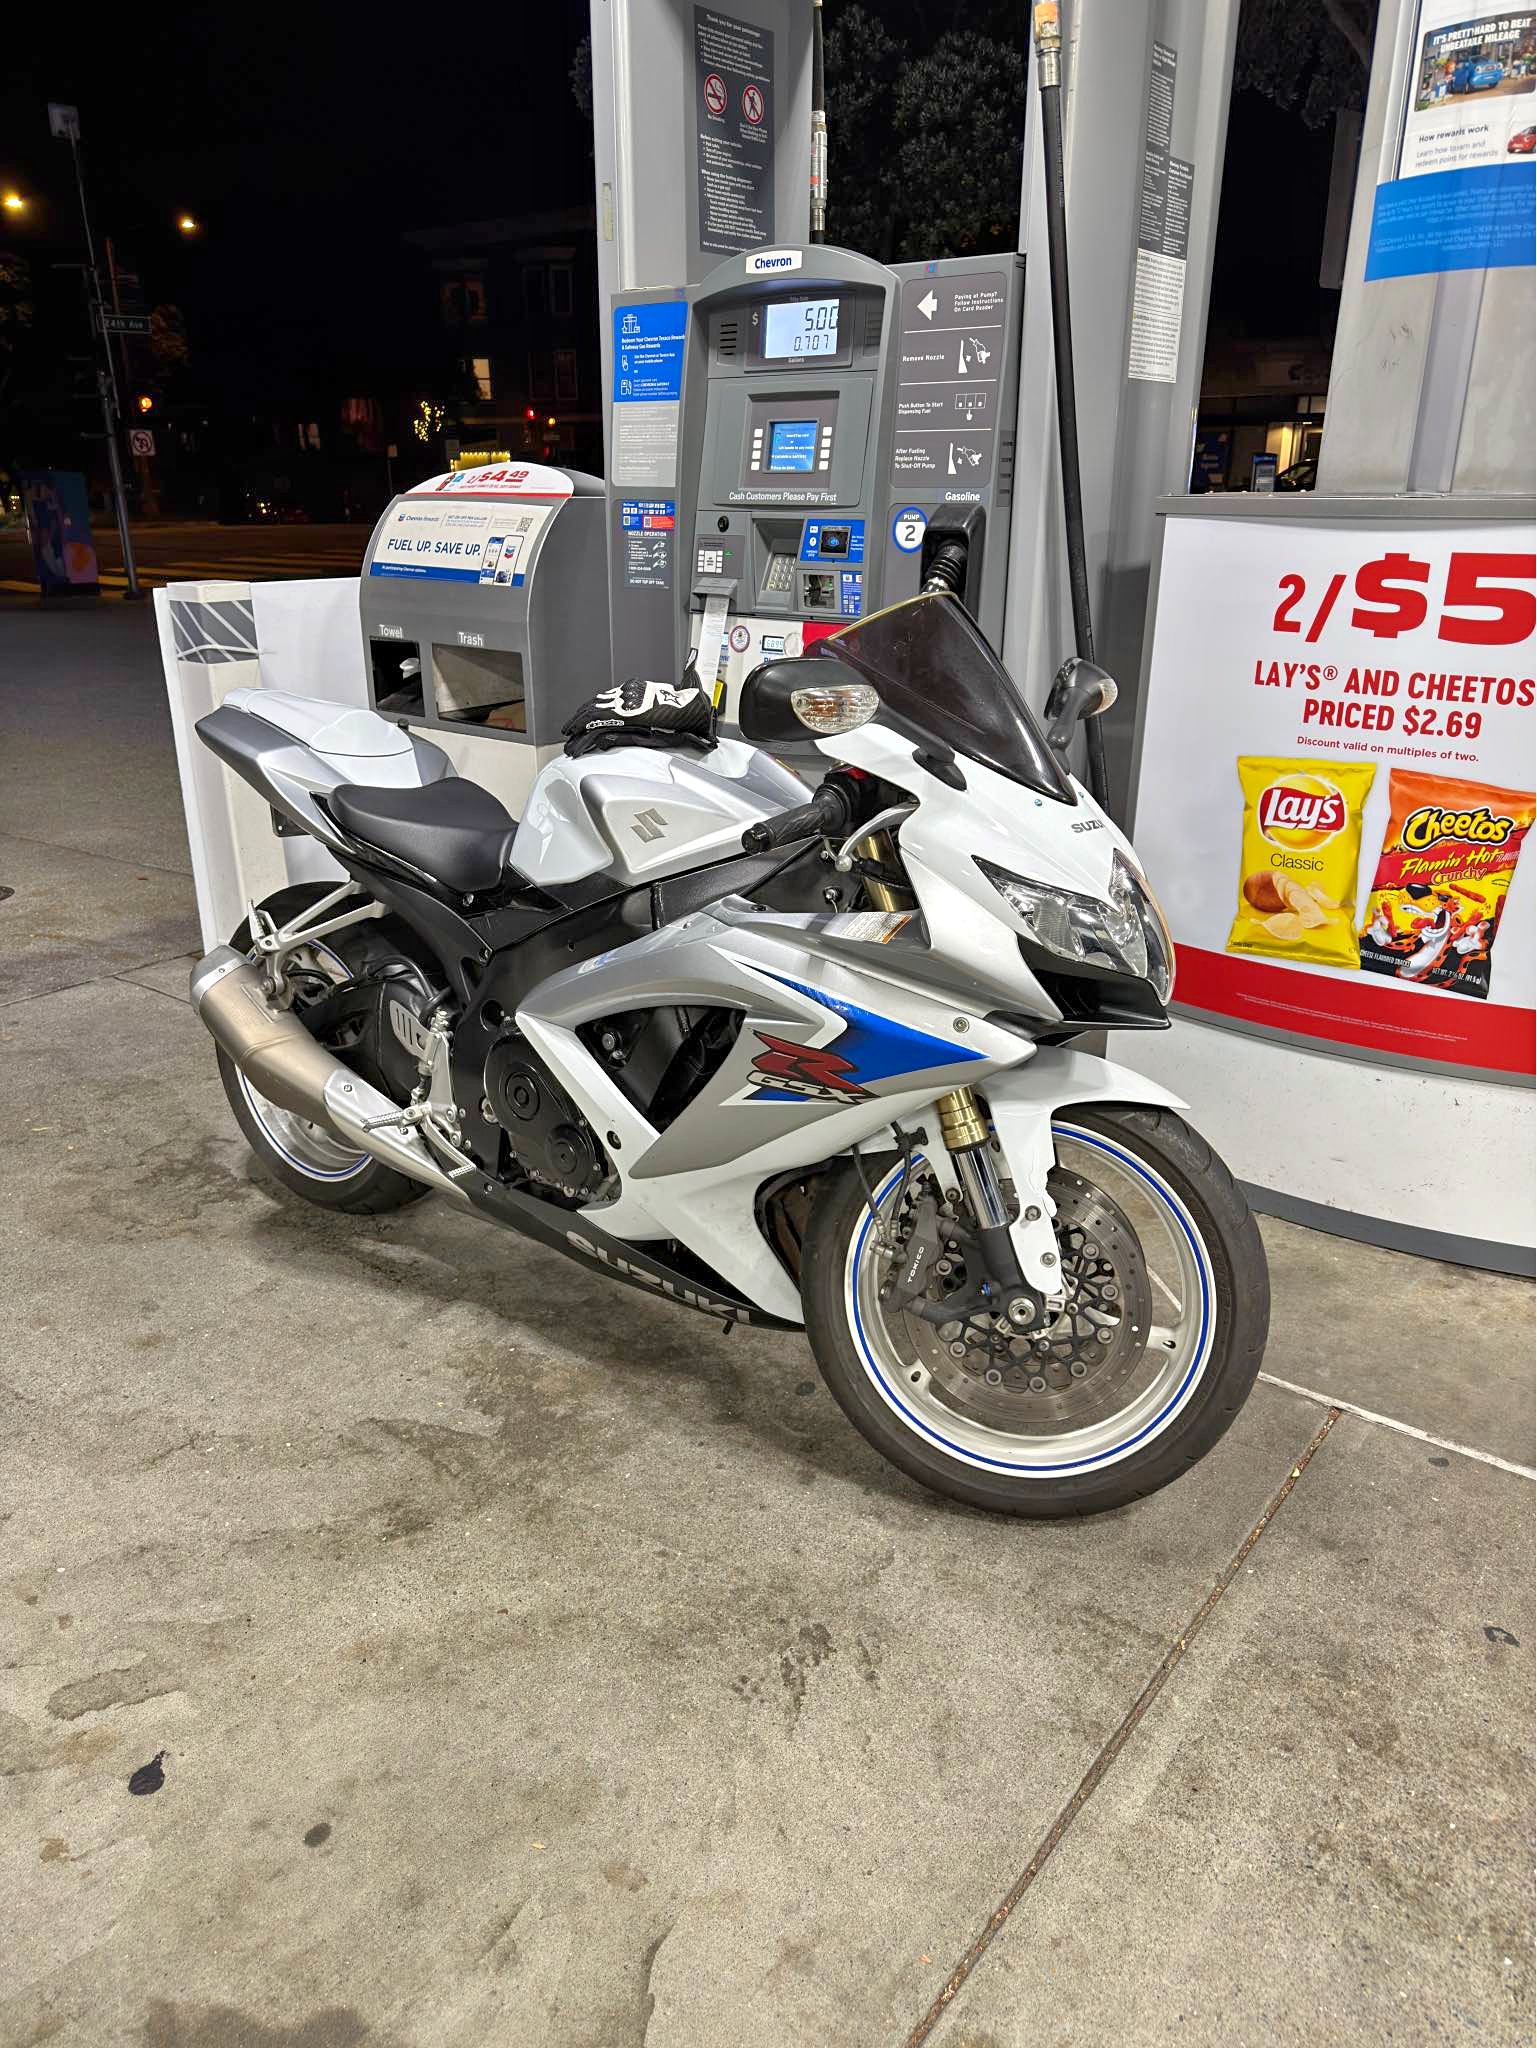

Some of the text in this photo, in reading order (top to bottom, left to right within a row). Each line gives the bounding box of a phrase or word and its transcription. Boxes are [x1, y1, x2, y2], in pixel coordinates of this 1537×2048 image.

[1433, 34, 1447, 45] IT'S
[1474, 23, 1496, 35] HARD
[1498, 21, 1509, 30] TO
[1511, 18, 1532, 29] BEAT
[1484, 29, 1521, 43] MILEAGE
[1419, 134, 1435, 143] How
[1468, 124, 1488, 133] work
[1417, 150, 1433, 158] Learn
[755, 257, 792, 269] Chevron
[752, 311, 759, 326] $
[794, 335, 829, 351] 0.707
[729, 491, 837, 502] Cash Customers Please Pay First
[945, 492, 981, 501] Gasoline
[904, 525, 916, 542] 2
[387, 539, 481, 556] FUEL UP. SAVE UP.
[1273, 551, 1536, 645] 2/$5
[379, 624, 403, 639] Towel
[459, 632, 483, 646] Trash
[1344, 667, 1400, 697] AND
[1408, 671, 1536, 707] CHEETOS
[1302, 698, 1482, 739] PRICED $2.69
[1297, 735, 1479, 763] Discount valid on multiples of two.
[1264, 789, 1340, 829] Lay's
[1404, 808, 1512, 848] Cheetos
[1270, 853, 1324, 872] Classic
[1400, 852, 1465, 880] Flamin'
[1467, 847, 1504, 866] Hot
[1431, 866, 1488, 886] Crunchy
[1360, 949, 1412, 968] CHEESE FLAVORED SNACKS
[1432, 967, 1440, 975] NET
[907, 1246, 925, 1284] TOKICO
